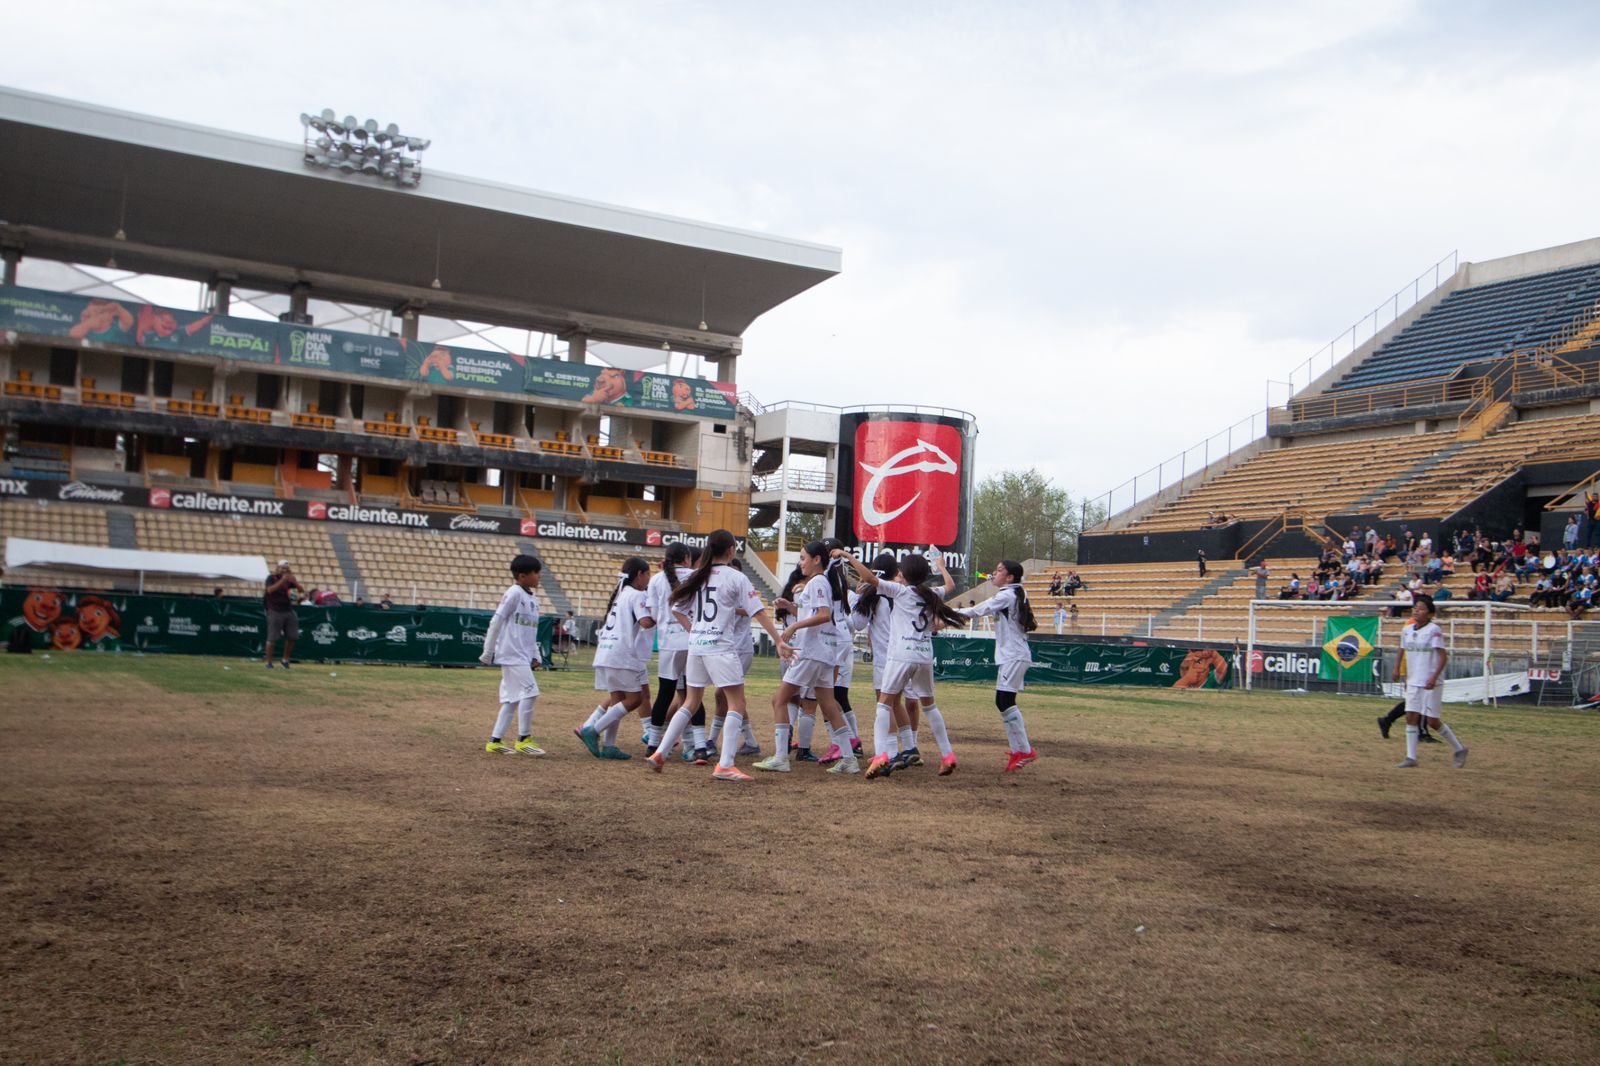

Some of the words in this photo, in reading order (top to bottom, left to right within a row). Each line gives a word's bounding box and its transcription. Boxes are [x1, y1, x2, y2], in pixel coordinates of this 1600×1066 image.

[209, 335, 269, 353] PAPÁ!
[306, 331, 332, 345] MUN
[306, 342, 327, 353] DIA
[456, 366, 502, 377] RESPIRA
[172, 492, 284, 515] caliente.mx
[328, 505, 429, 527] caliente.mx
[538, 521, 628, 542] caliente.mx
[662, 533, 744, 551] calienx
[696, 586, 719, 623] 15
[415, 631, 453, 642] SaludDigna
